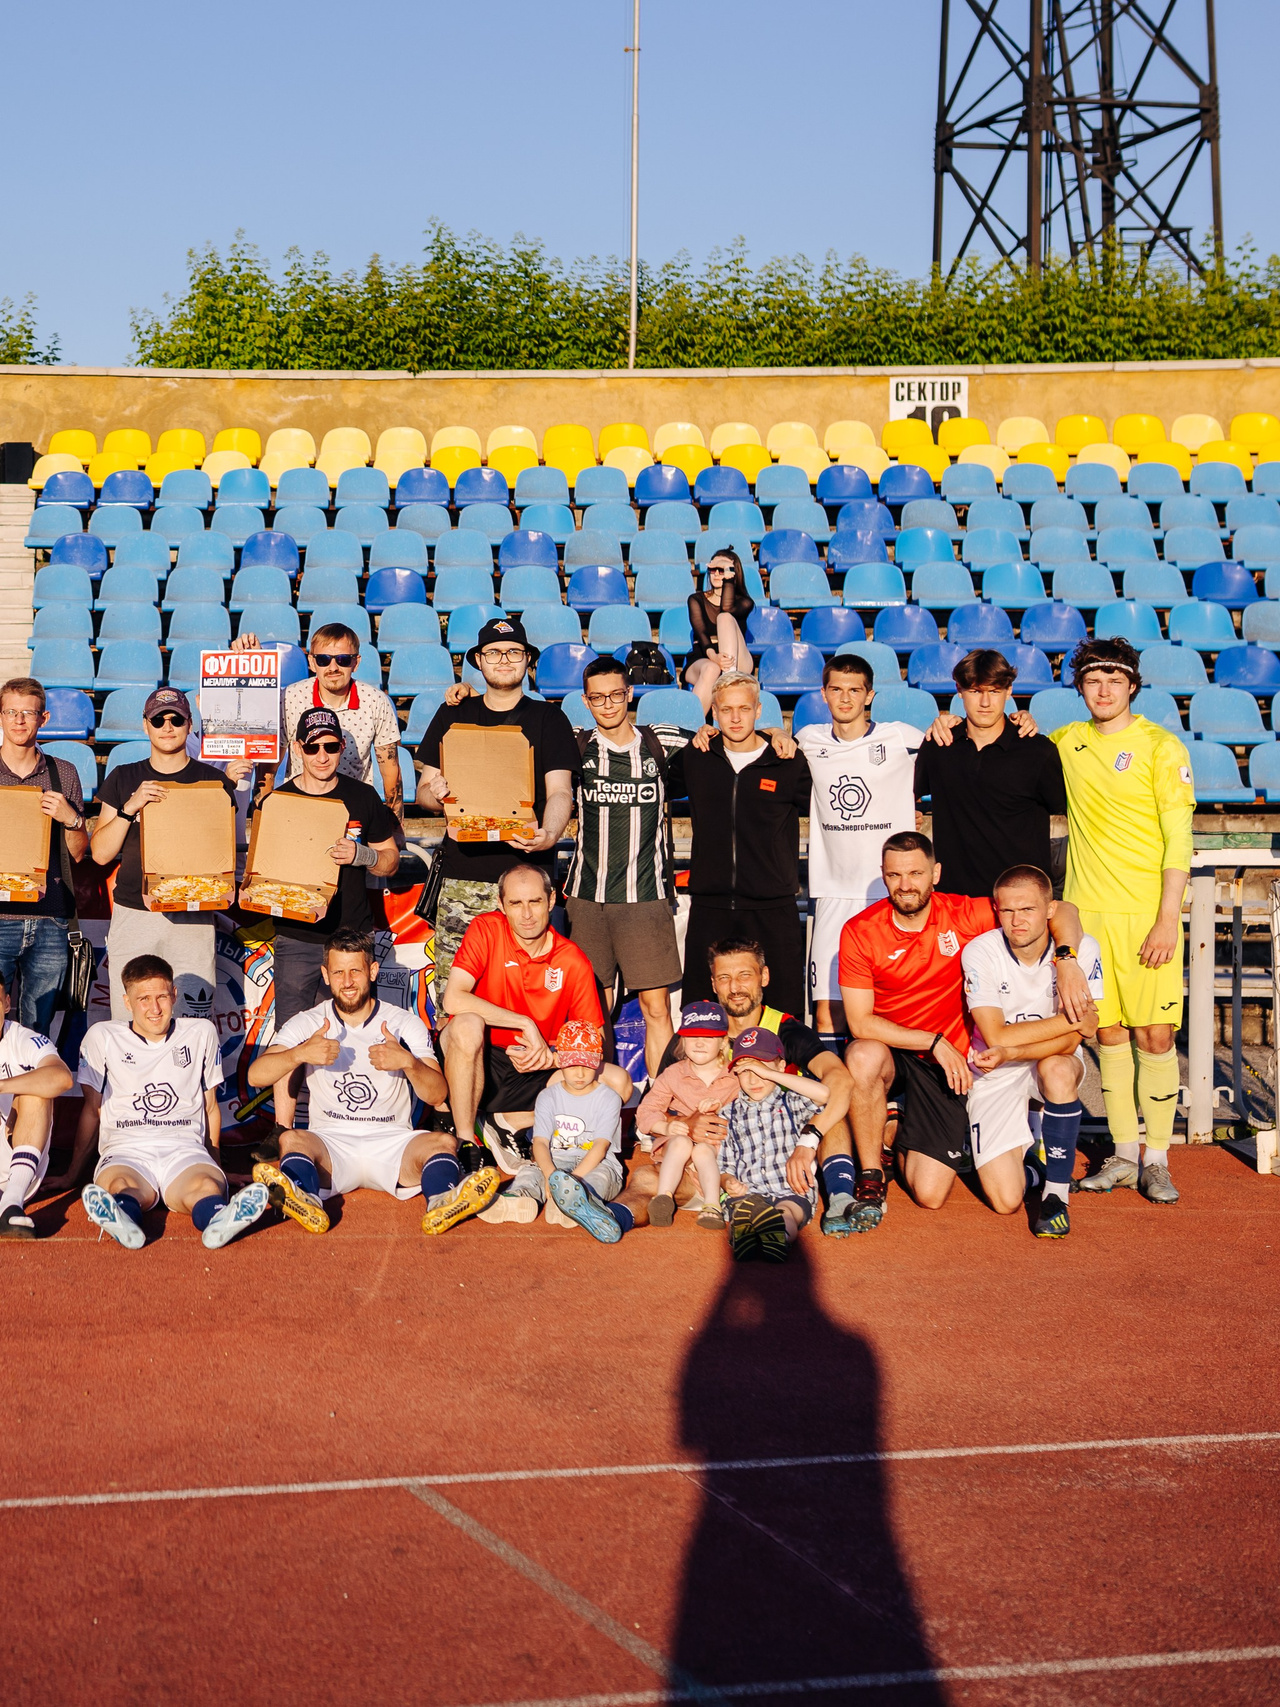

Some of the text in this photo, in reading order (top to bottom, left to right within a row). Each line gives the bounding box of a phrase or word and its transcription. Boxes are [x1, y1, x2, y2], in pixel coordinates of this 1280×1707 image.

[895, 381, 962, 402] СЕКТОР
[204, 654, 276, 676] ФУТБОЛ
[583, 788, 636, 803] Viewer
[593, 780, 636, 793] Team
